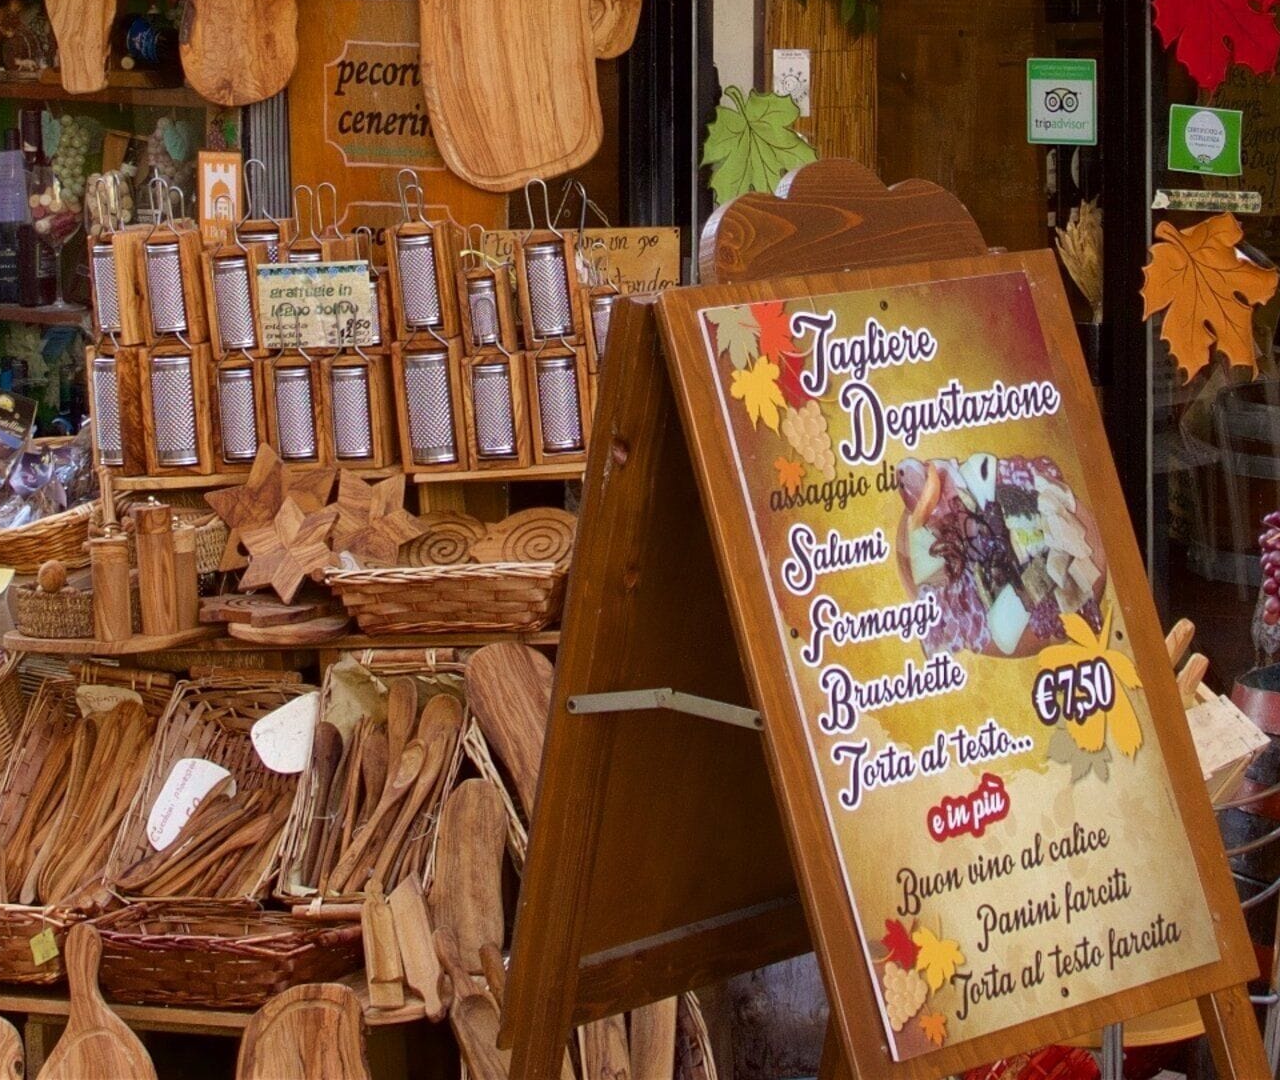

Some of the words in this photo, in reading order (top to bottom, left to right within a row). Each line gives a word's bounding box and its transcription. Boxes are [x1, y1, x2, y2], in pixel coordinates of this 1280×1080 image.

[333, 56, 421, 97] pecori
[1035, 117, 1088, 131] tripadvisor
[339, 283, 353, 296] in
[792, 313, 936, 393] Tagliere
[841, 381, 1059, 462] Degustazione
[770, 473, 871, 512] assaggio
[784, 527, 888, 592] Salumi
[803, 595, 940, 663] Formaggi
[820, 655, 965, 731] Bruschette
[833, 741, 914, 807] Torta
[921, 733, 948, 772] al
[932, 814, 945, 834] e
[946, 803, 970, 831] in
[972, 781, 1005, 830] più
[896, 867, 964, 917] Buon
[967, 853, 1016, 886] vino
[1020, 832, 1045, 870] al
[1048, 821, 1111, 862] calice
[976, 891, 1061, 953] Panini
[1064, 868, 1132, 924] farciti
[950, 963, 1017, 1021] Torta
[1021, 950, 1045, 989] al
[1047, 936, 1104, 979] testo
[1108, 913, 1182, 970] farcita
